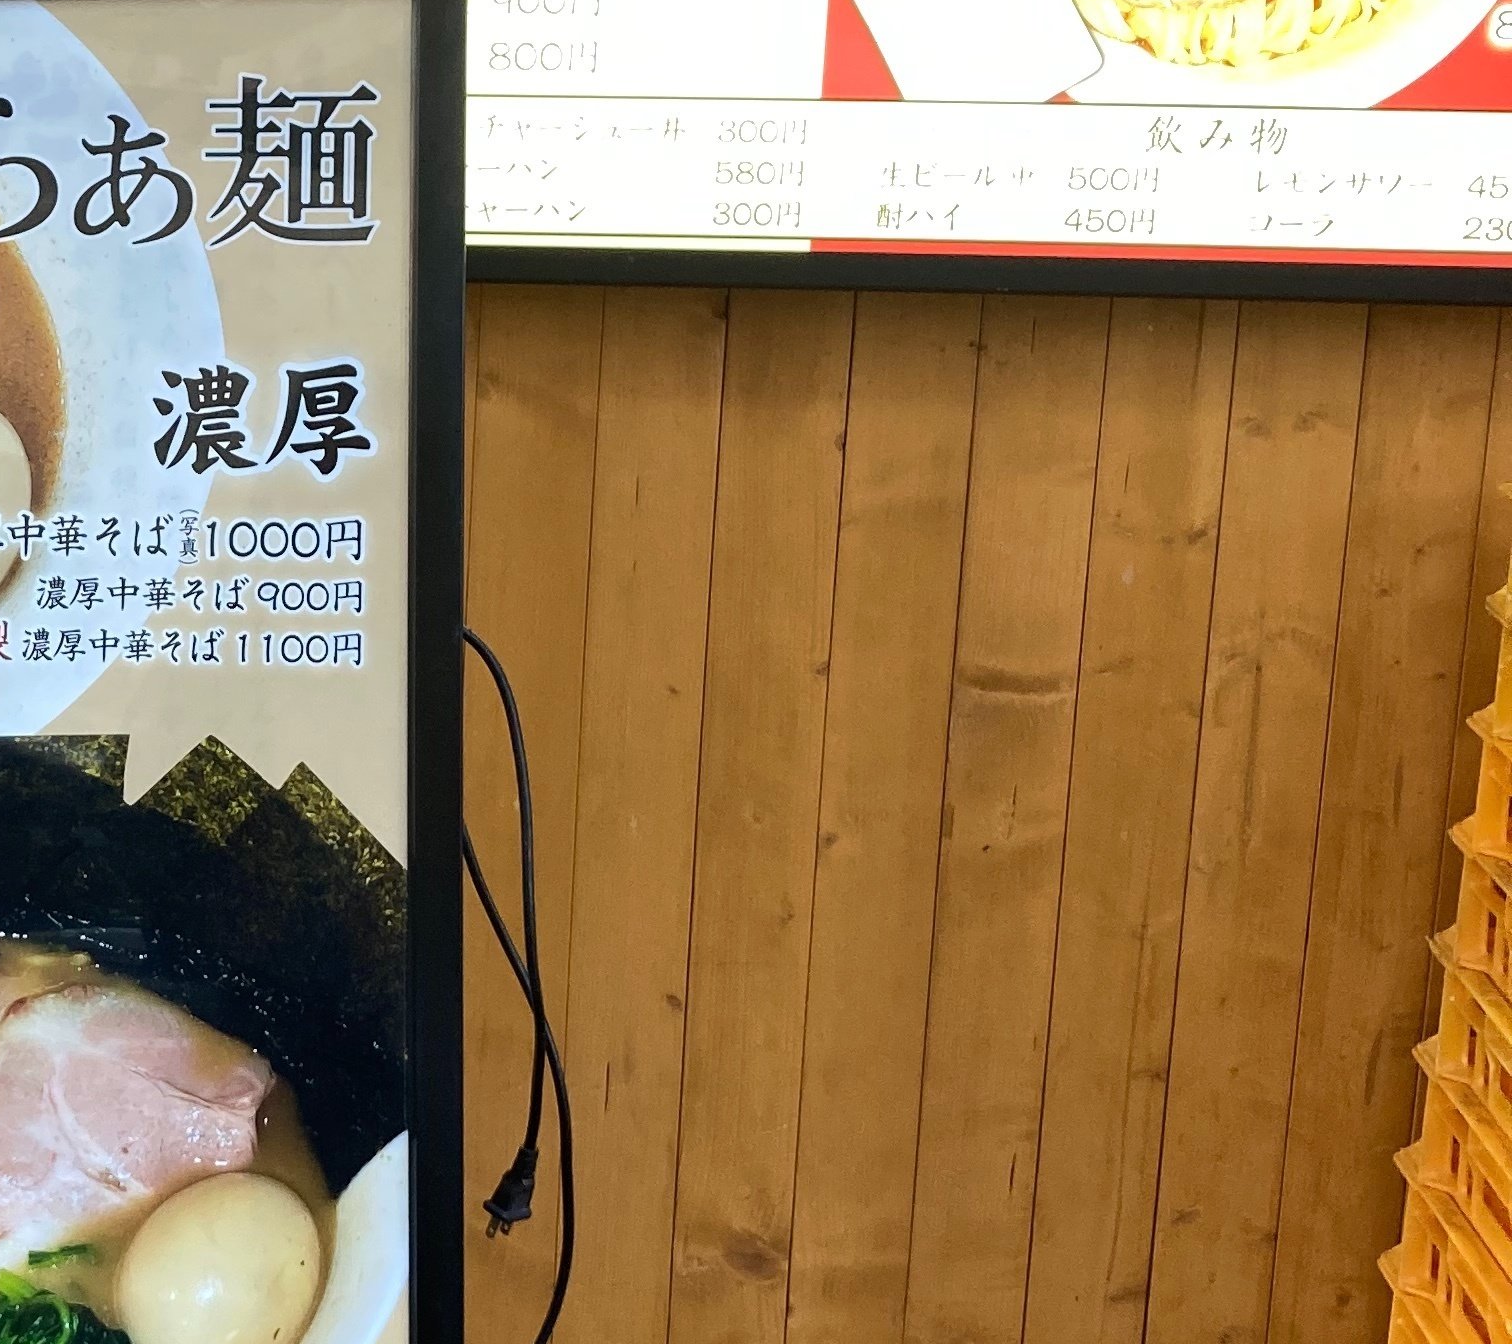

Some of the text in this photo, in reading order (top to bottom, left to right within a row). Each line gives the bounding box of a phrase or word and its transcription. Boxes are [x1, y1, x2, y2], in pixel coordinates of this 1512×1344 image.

[1144, 115, 1288, 156] 飲み物
[715, 160, 804, 187] 580円
[1067, 166, 1159, 193] 500円
[712, 201, 801, 229] 300円
[876, 202, 1156, 235] 酎ハイ 450円
[152, 363, 372, 476] 濃厚
[206, 519, 362, 561] 1000円
[36, 576, 362, 613] 濃厚中華そば 900円
[22, 627, 225, 663] 濃厚中華そば
[238, 633, 362, 666] 1100円
